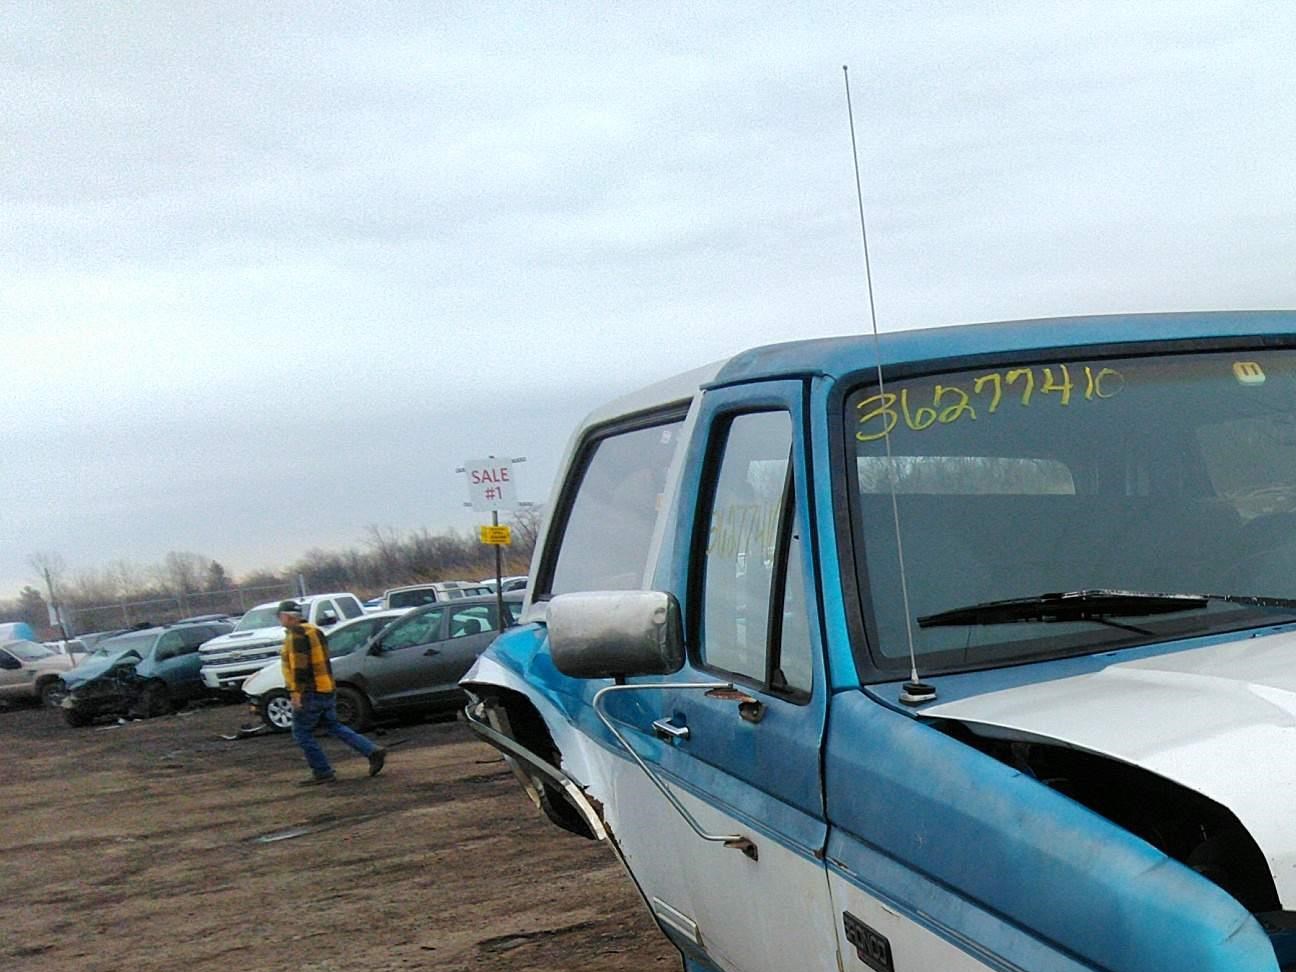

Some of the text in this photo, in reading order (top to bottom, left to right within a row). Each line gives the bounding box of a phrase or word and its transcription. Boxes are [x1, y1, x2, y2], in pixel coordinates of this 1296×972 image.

[855, 363, 1125, 442] 36277410
[471, 467, 510, 485] SALE
[484, 486, 503, 501] #1
